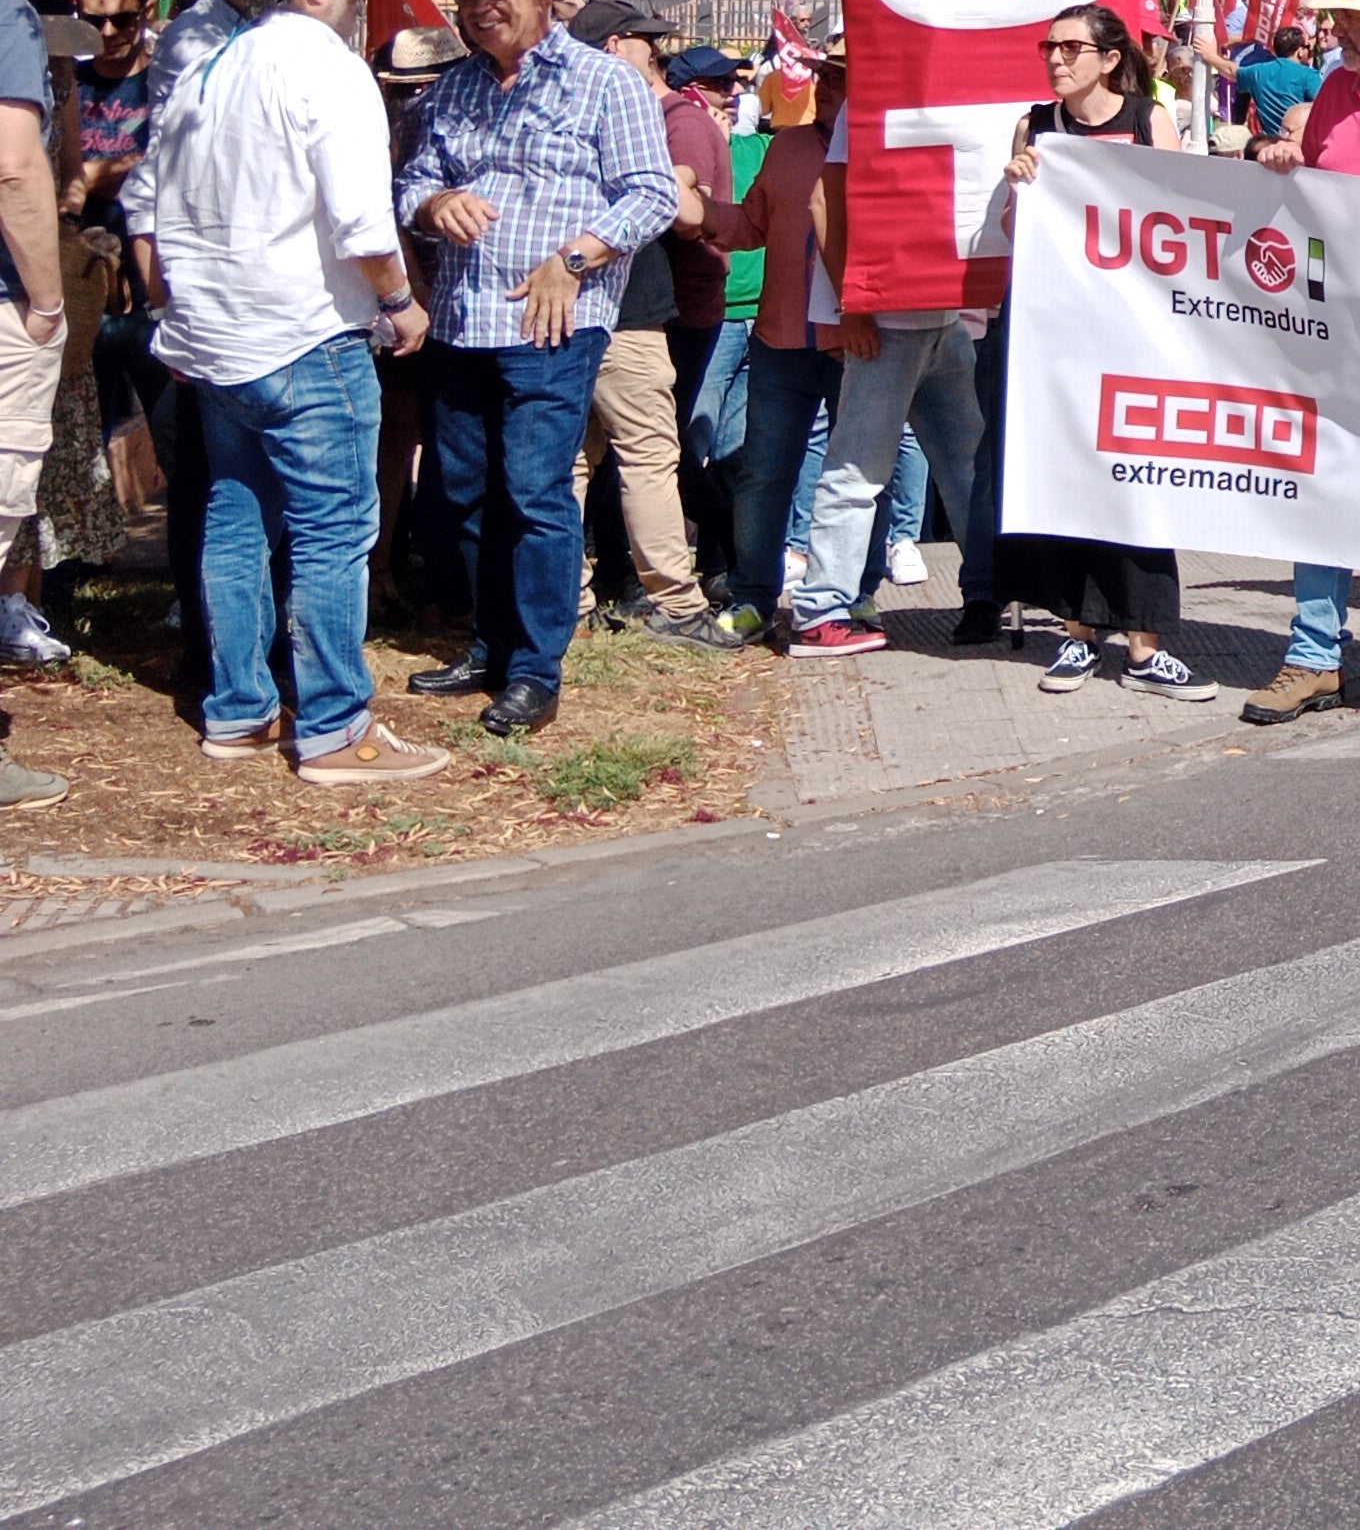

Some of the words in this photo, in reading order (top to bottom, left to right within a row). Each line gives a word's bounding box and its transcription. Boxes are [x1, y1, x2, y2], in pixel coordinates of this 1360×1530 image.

[1084, 204, 1232, 281] UGT
[1171, 289, 1331, 341] Extremadura
[1111, 390, 1305, 458] CCOO
[1111, 459, 1300, 501] extremadura
